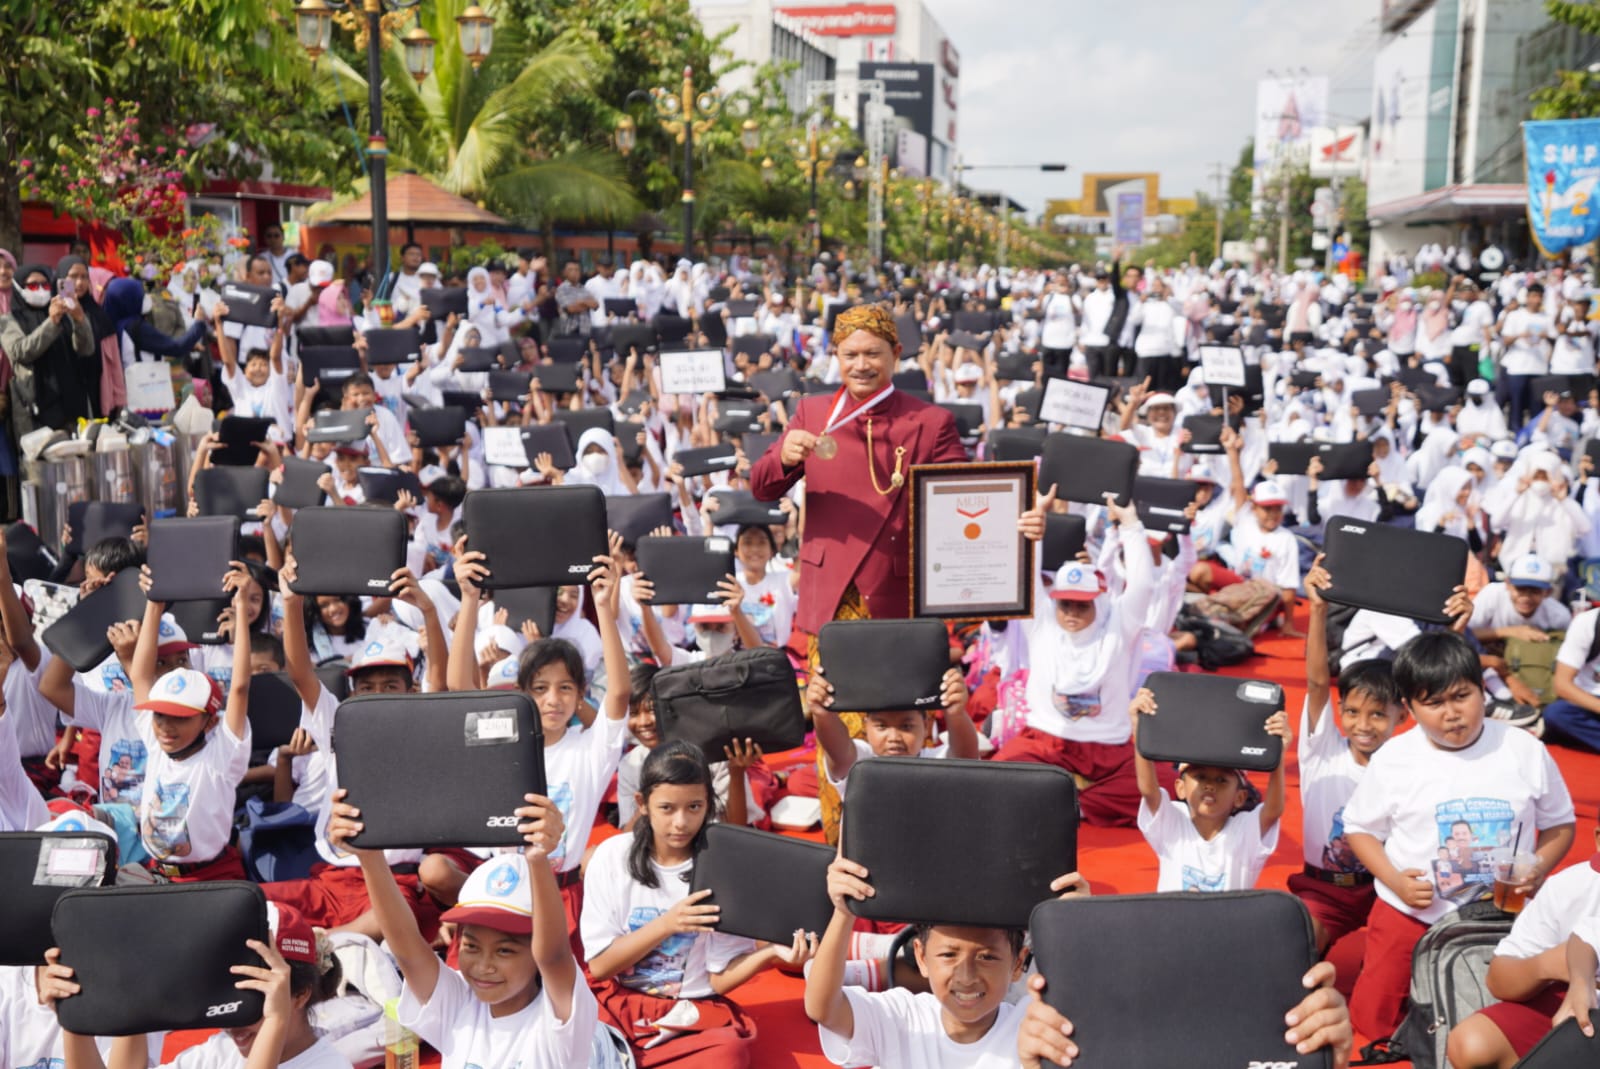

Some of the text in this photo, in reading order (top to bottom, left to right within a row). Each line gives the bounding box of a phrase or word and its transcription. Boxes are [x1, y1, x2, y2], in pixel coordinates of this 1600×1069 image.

[1571, 192, 1590, 215] 2
[568, 565, 592, 573] acer
[367, 579, 389, 587] acer
[915, 695, 938, 704] acer
[1241, 746, 1267, 756] acer
[486, 816, 522, 827] acer
[206, 1000, 243, 1017] acer
